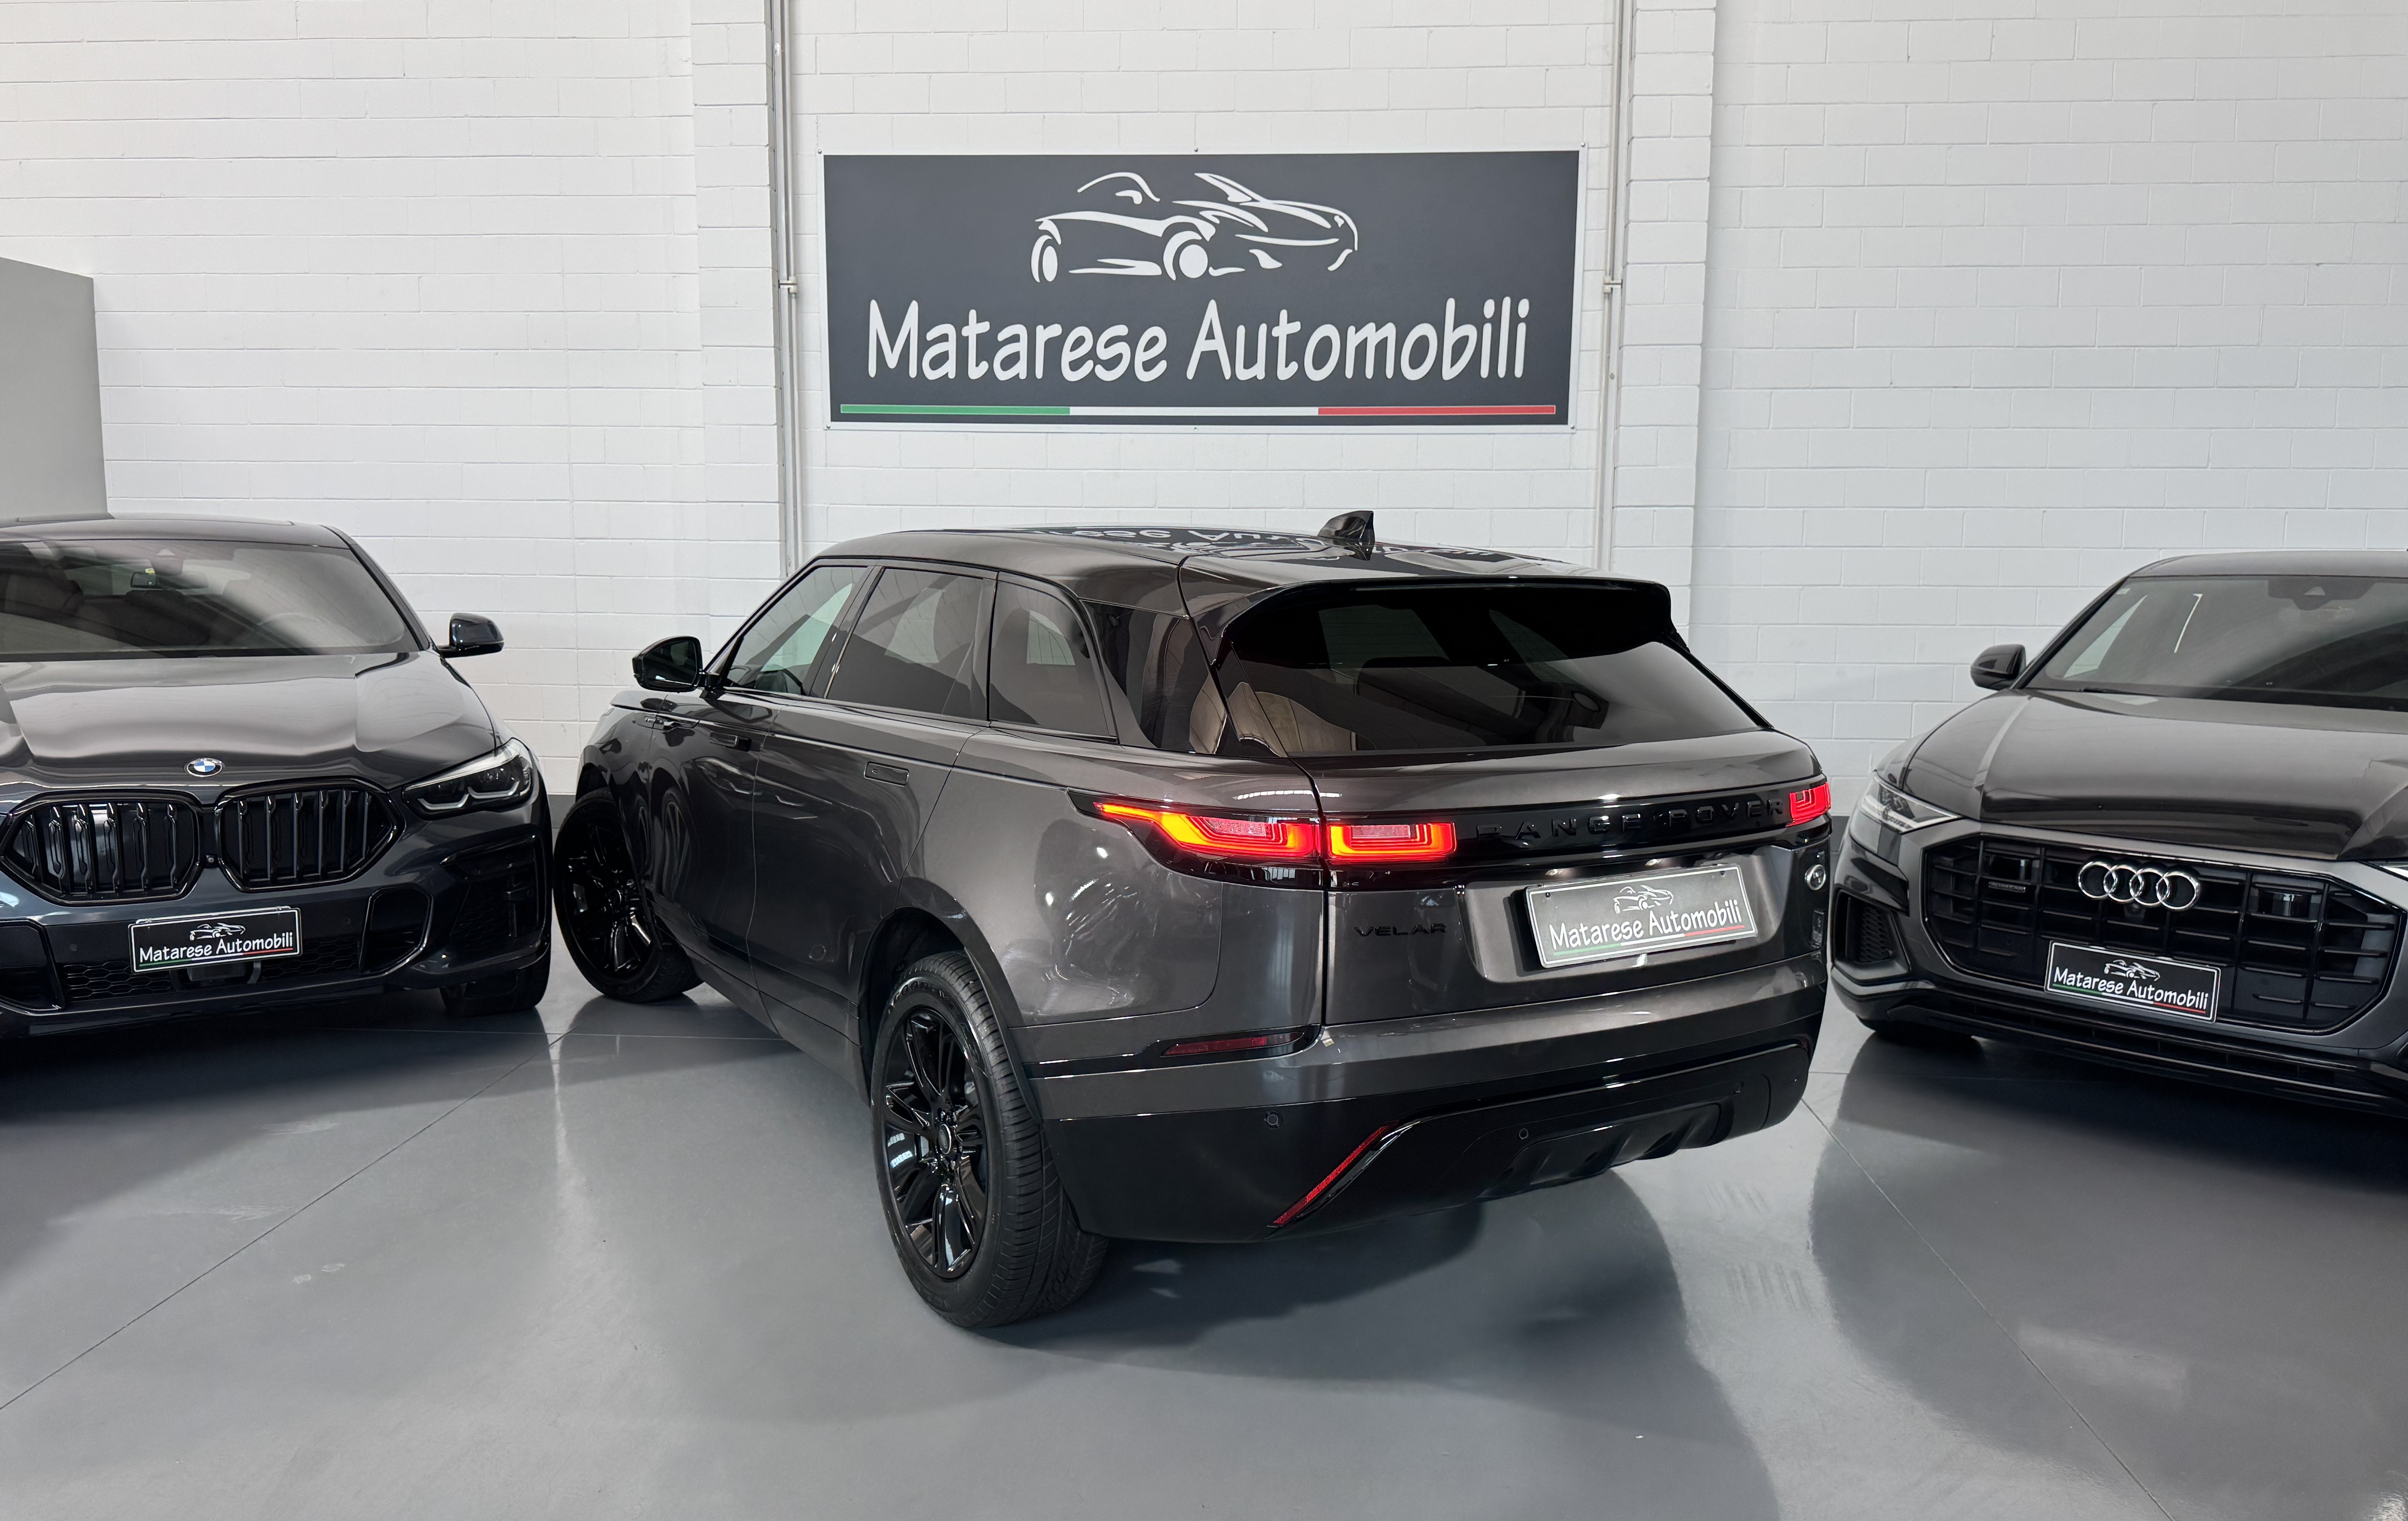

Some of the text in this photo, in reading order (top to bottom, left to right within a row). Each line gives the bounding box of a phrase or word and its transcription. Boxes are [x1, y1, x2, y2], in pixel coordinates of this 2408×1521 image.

[868, 296, 1530, 382] Matarese Automobili
[1354, 923, 1446, 937] VELAR
[1549, 899, 1742, 950] Matarese Automobili
[140, 931, 293, 963] Matarese Automobili
[2053, 966, 2209, 1010] Matarese Automobili
